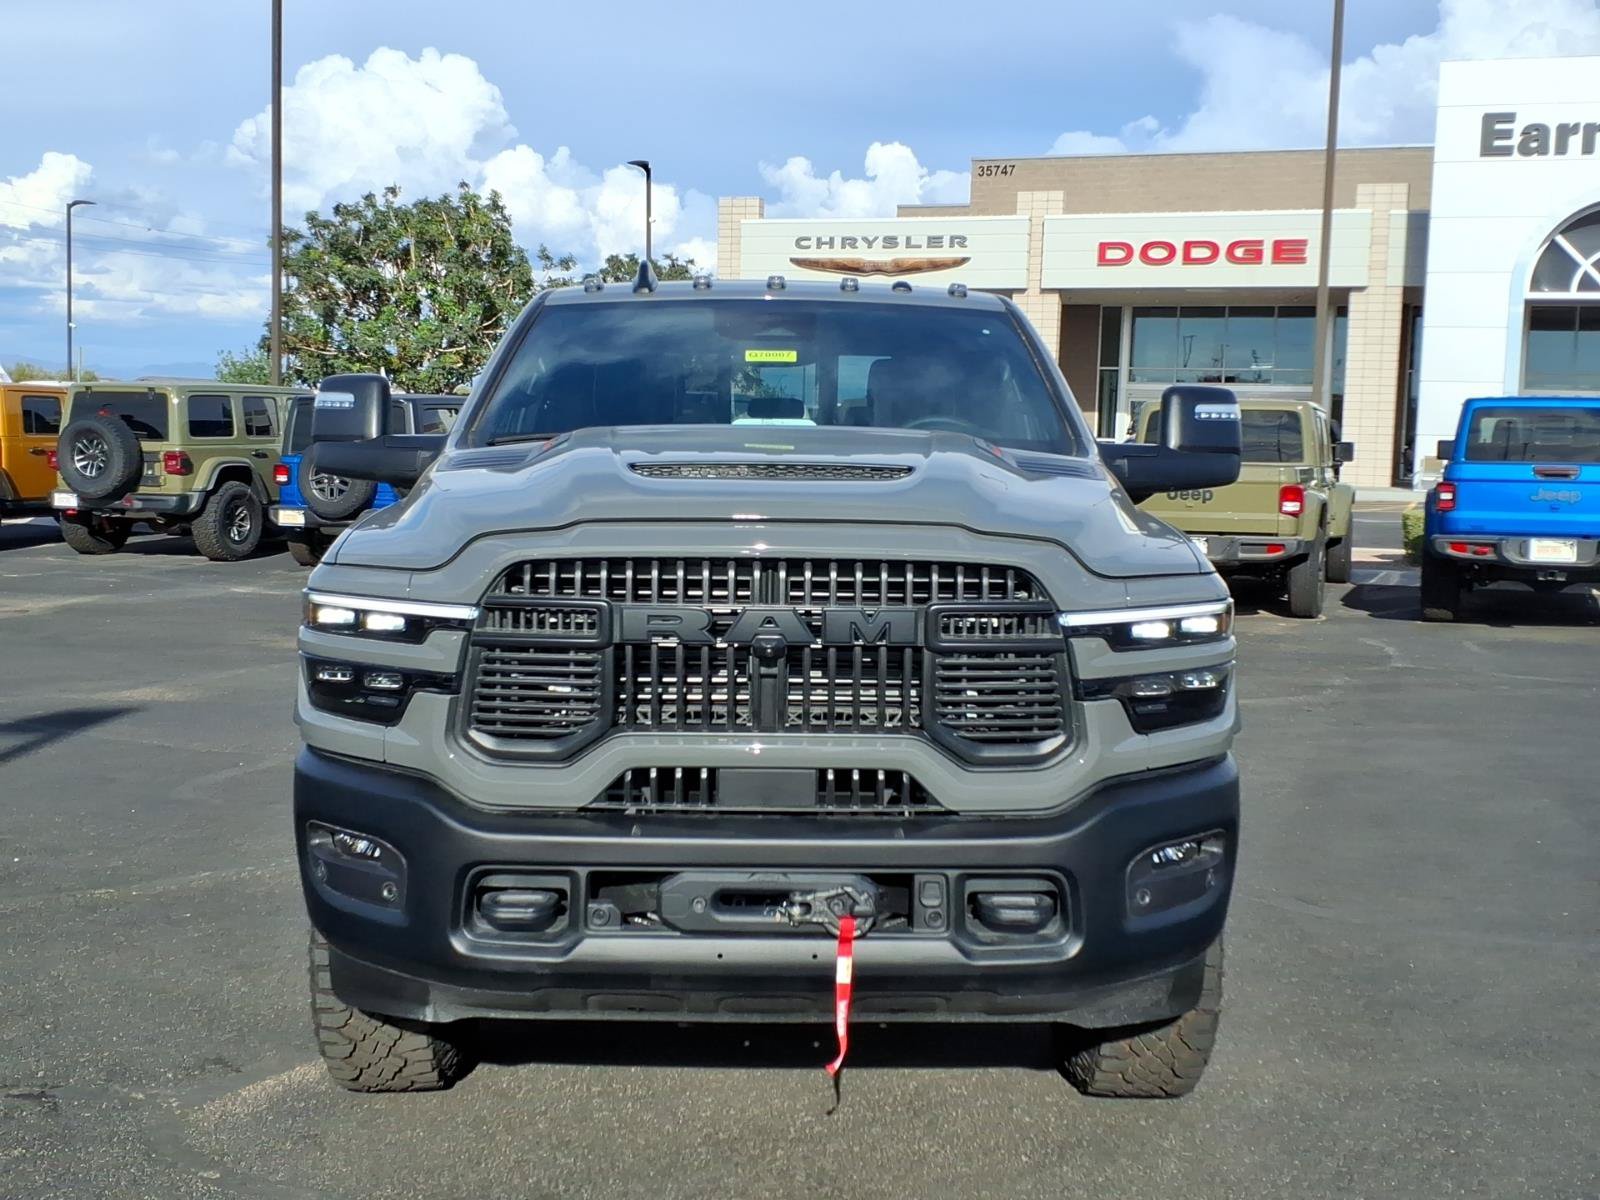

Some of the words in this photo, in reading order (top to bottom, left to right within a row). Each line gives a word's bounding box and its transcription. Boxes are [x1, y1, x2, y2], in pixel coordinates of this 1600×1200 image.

[978, 164, 1016, 177] 35747
[795, 235, 968, 249] CHRYSLER
[1097, 239, 1309, 266] DODGE
[1530, 488, 1582, 504] Jeep
[622, 607, 917, 645] RAM
